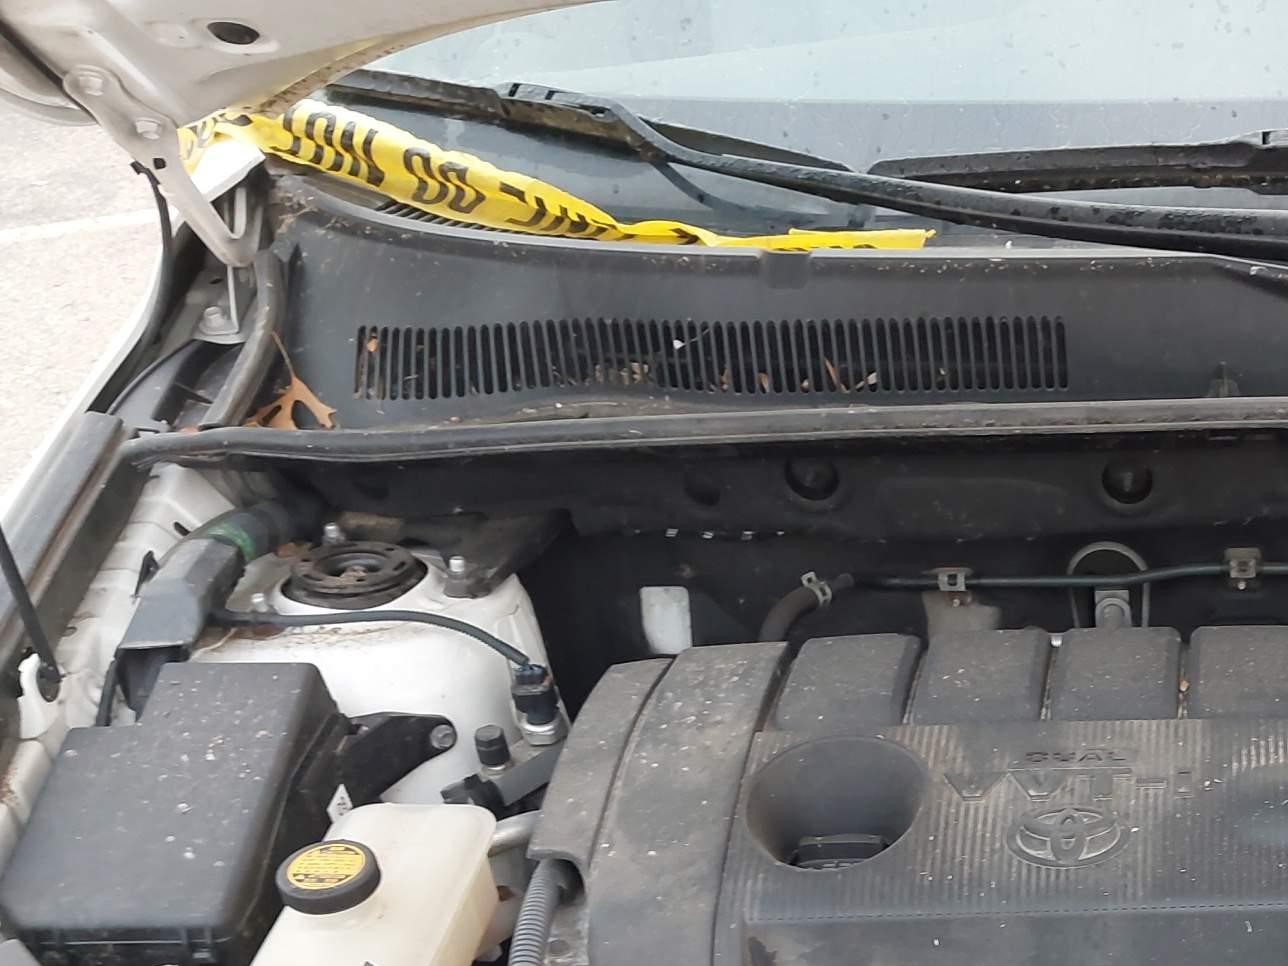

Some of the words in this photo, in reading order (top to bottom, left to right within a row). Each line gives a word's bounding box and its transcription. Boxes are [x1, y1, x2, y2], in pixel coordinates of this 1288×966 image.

[269, 100, 386, 187] NOT
[404, 147, 487, 214] DO
[1025, 751, 1127, 763] DUAL
